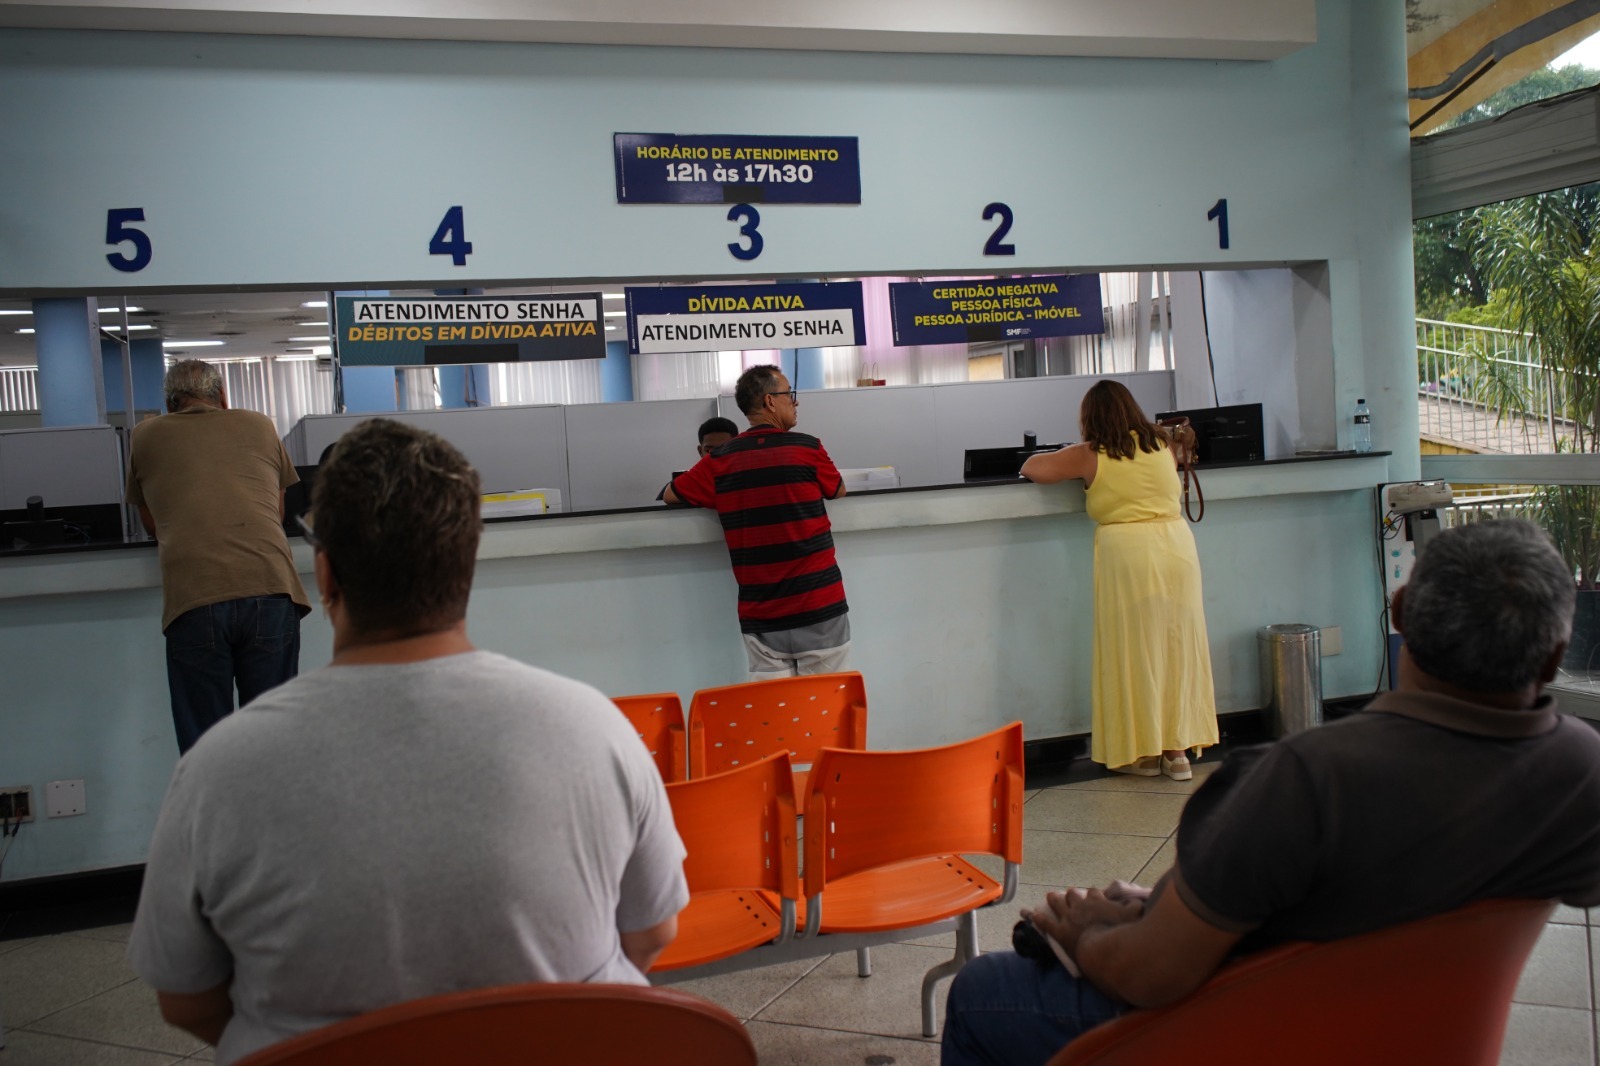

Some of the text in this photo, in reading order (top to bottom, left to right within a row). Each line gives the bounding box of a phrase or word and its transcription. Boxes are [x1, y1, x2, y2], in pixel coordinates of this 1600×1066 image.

[636, 144, 839, 161] HORÁRIO DE ATENDIMENTO
[666, 162, 813, 183] 12h às 17h30
[727, 203, 763, 260] 3
[982, 203, 1015, 255] 2
[1207, 199, 1228, 249] 1
[106, 209, 152, 272] 5
[429, 206, 472, 266] 4
[932, 282, 1059, 300] CERTIDÃO NEGATIVA
[358, 302, 585, 320] ATENDIMENTO SENHA
[688, 294, 805, 312] DÍVIDA ATIVA
[951, 296, 1043, 312] PESSOA FÍSICA
[914, 313, 964, 327] PESSOA
[965, 309, 1023, 325] JURÍDICA
[1034, 305, 1082, 321] IMÓVEL
[347, 321, 597, 342] DÉBITOS EM DÍVIDA ATIVA
[641, 319, 844, 341] ATENDIMENTO SENHA
[1006, 328, 1021, 336] SMF
